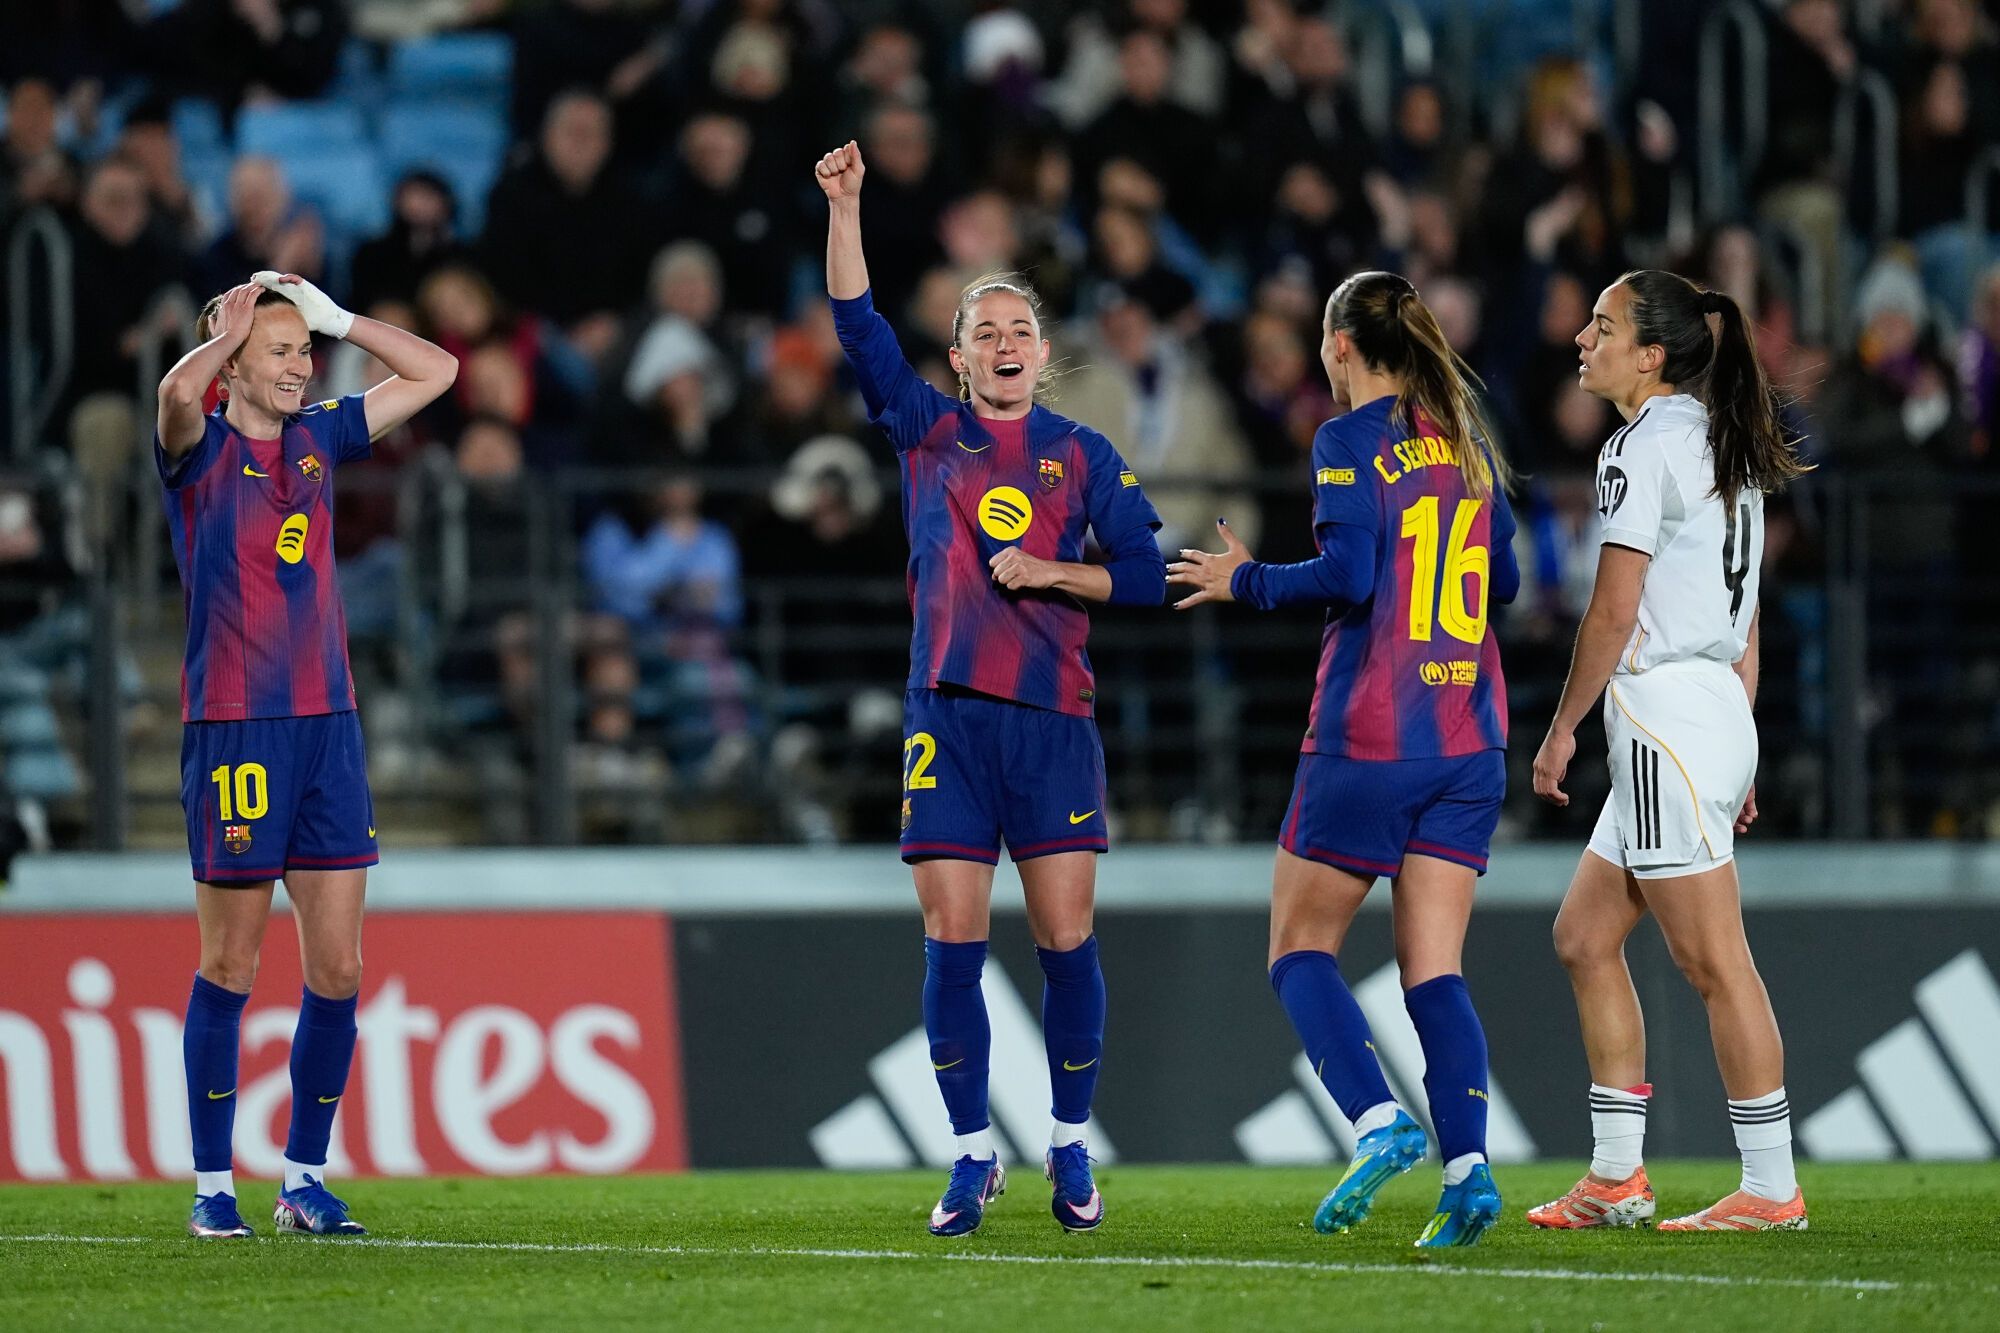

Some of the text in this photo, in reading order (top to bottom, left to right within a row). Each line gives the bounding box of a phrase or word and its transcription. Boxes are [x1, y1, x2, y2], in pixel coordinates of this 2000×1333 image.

[1599, 465, 1626, 519] hp
[1401, 496, 1490, 644] 16
[1722, 503, 1751, 629] 4
[211, 762, 269, 821] 10
